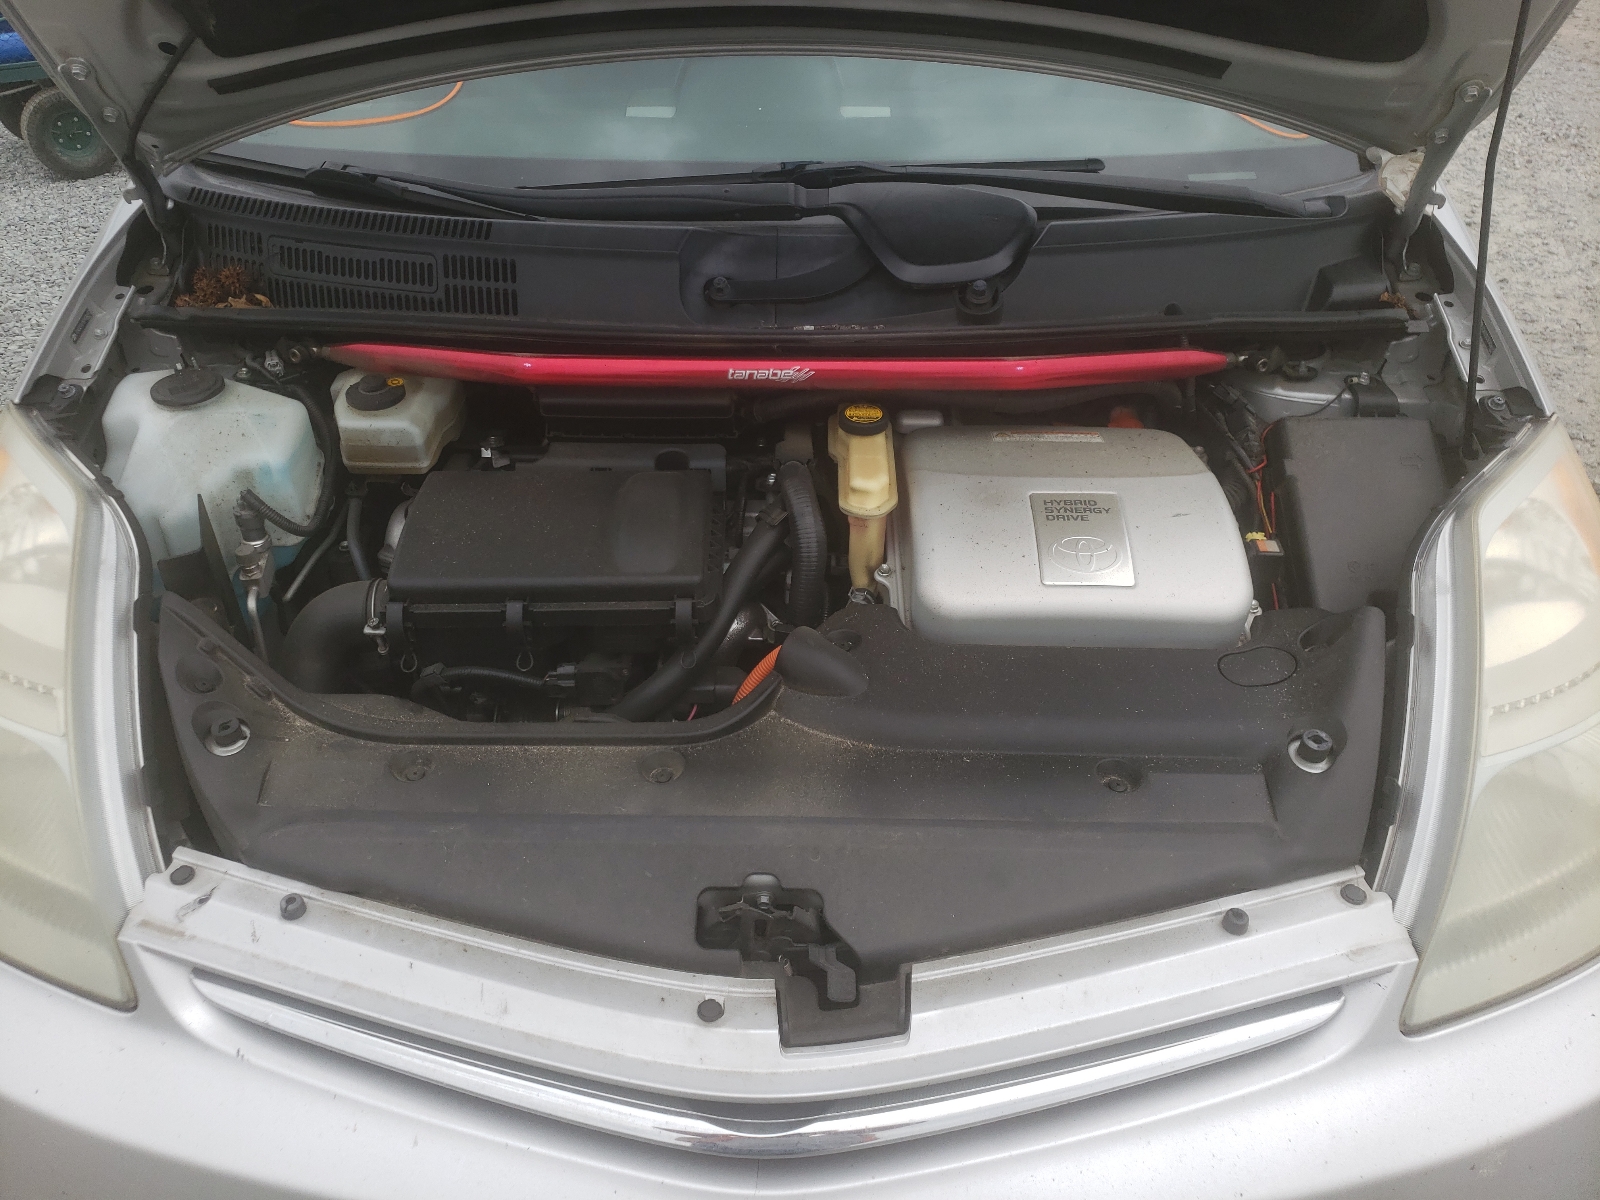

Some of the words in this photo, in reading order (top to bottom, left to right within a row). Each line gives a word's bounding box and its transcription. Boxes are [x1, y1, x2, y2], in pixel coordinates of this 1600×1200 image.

[727, 368, 795, 380] tanabe
[1043, 499, 1098, 507] HYBRID
[1046, 514, 1090, 522] DRIVE
